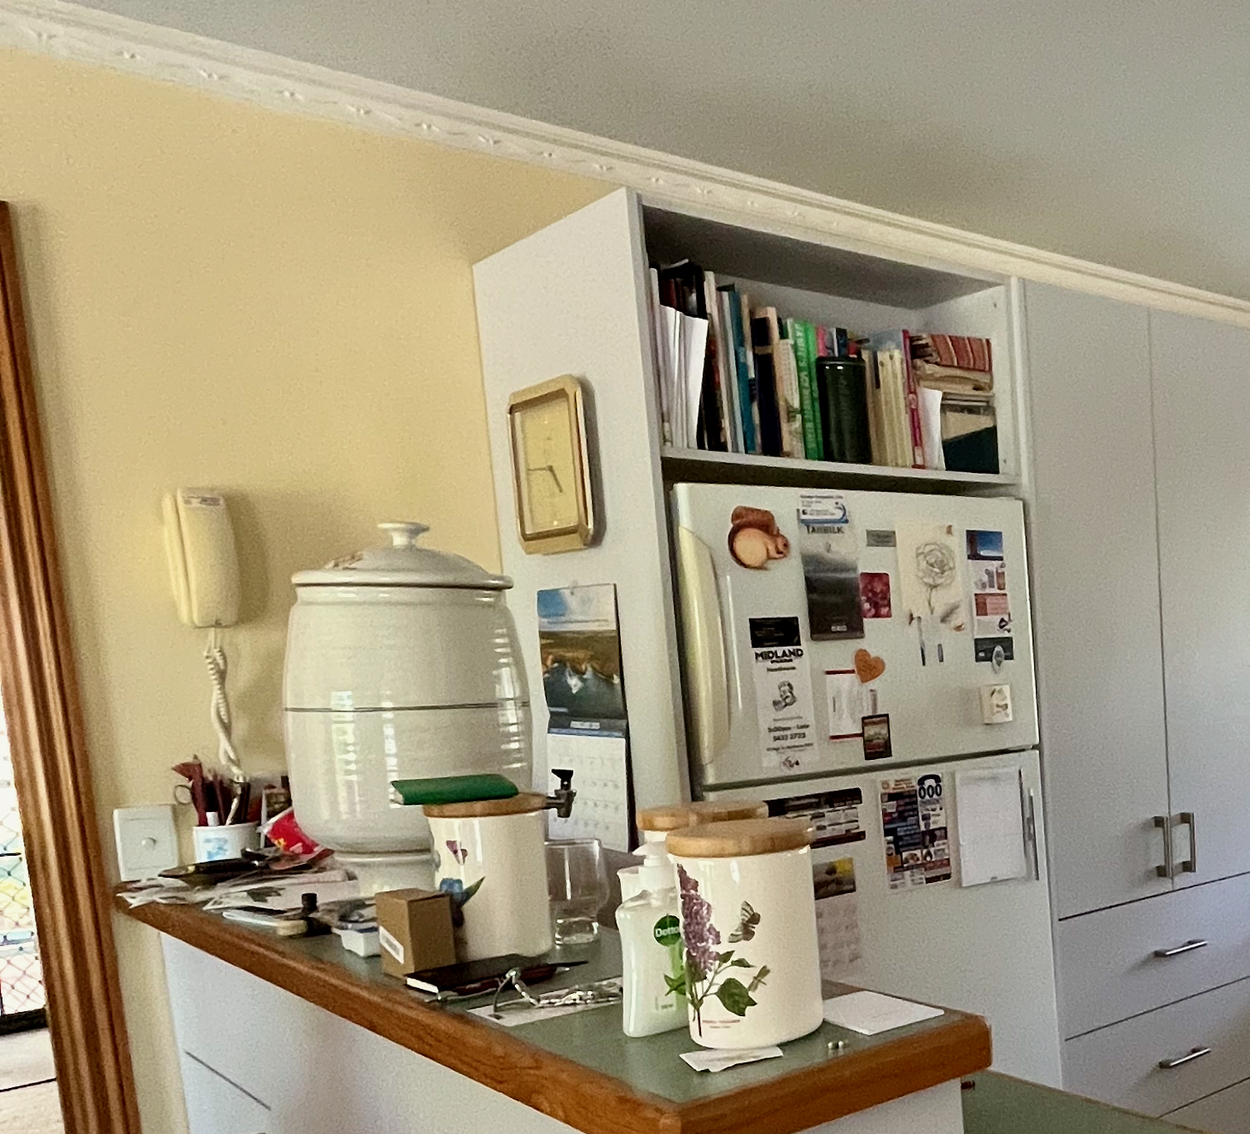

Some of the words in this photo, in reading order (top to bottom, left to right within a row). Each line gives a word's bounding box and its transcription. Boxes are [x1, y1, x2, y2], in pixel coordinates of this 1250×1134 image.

[754, 648, 804, 660] MIDLAND
[918, 783, 942, 799] 000
[655, 926, 680, 938] Detto
